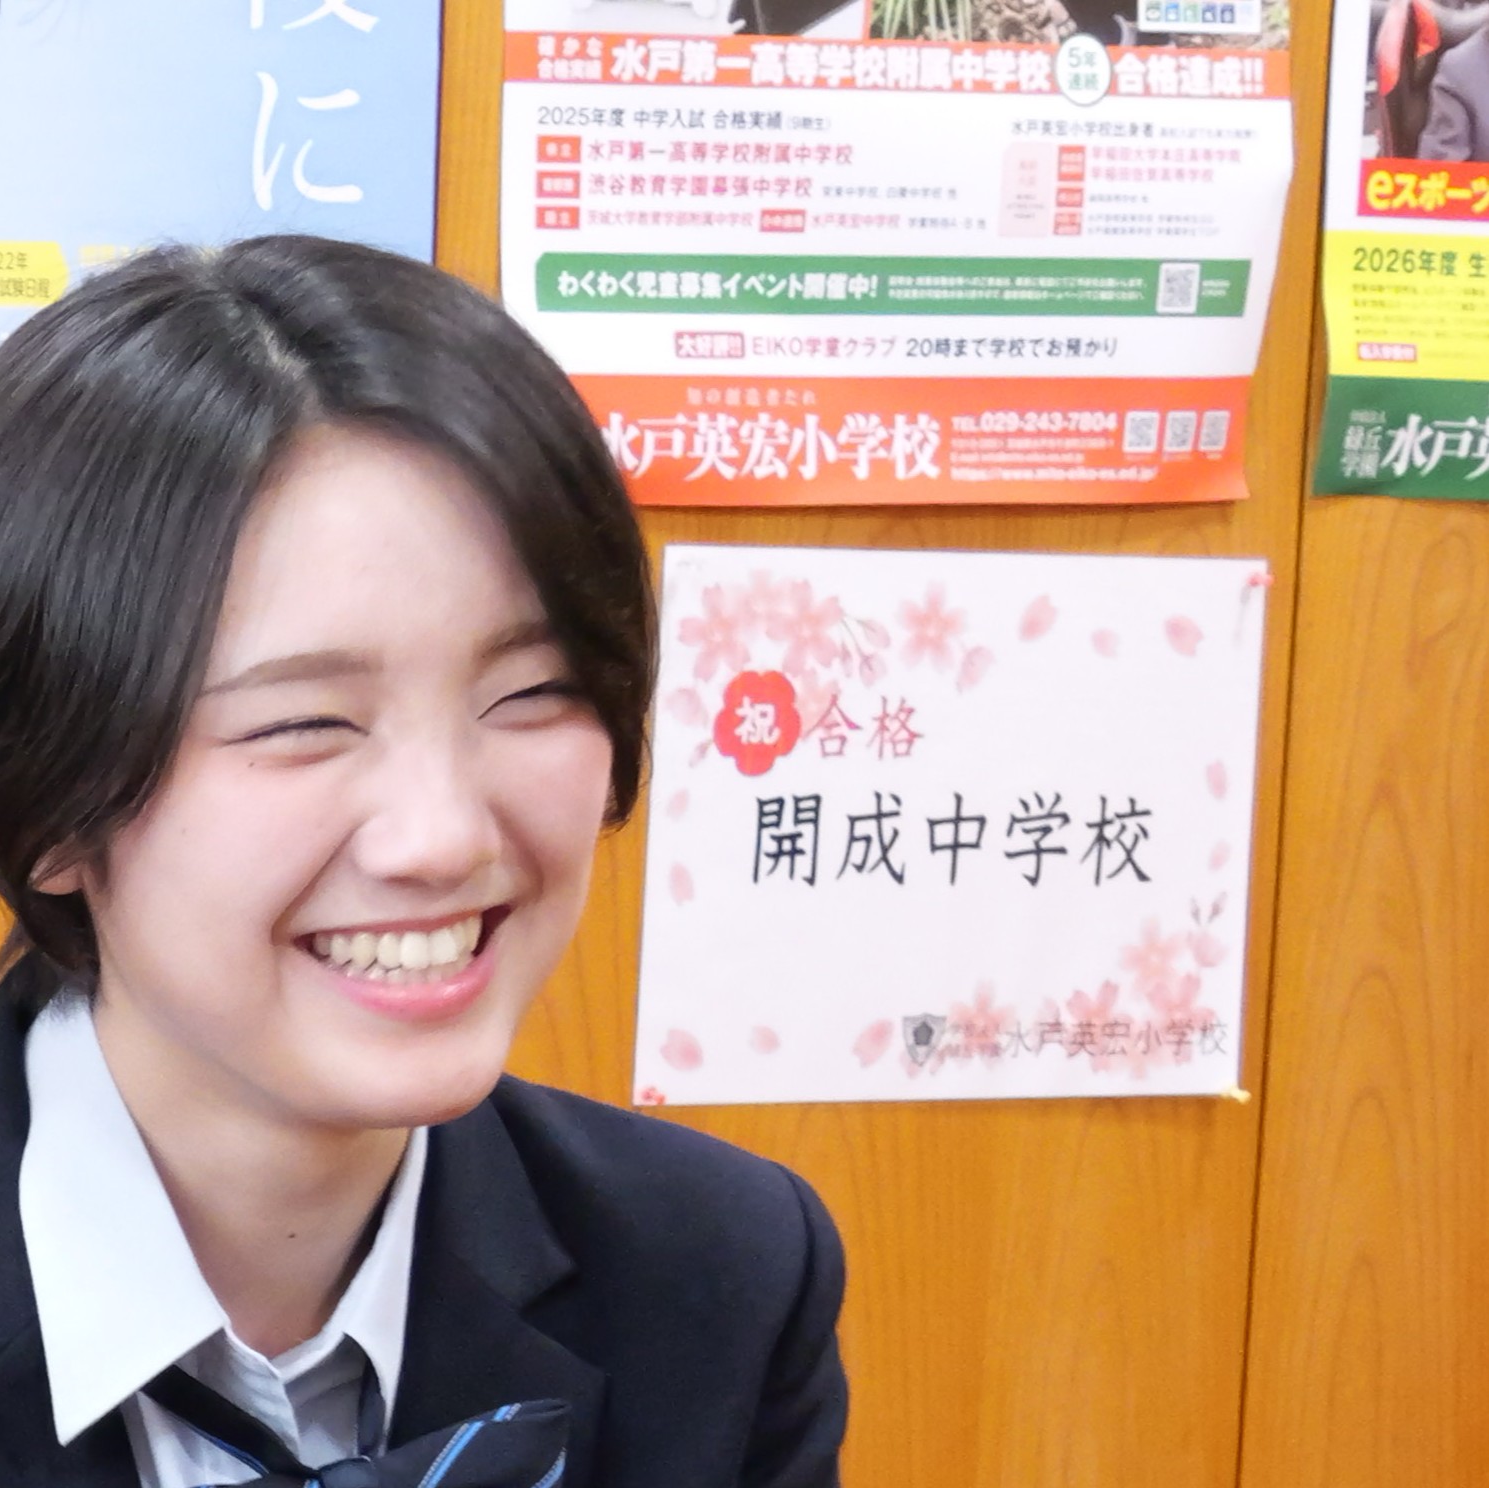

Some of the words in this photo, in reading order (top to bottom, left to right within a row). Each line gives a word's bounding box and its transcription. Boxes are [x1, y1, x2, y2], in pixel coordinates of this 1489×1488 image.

[1066, 47, 1098, 68] 5年
[536, 105, 626, 128] 2025年度
[634, 108, 705, 130] 中学入試
[1352, 246, 1459, 279] 2026年度
[1380, 413, 1489, 481] 水戸
[733, 698, 780, 746] 祝
[803, 693, 926, 762] 合格
[751, 790, 1154, 888] 開成中学校
[1005, 1018, 1228, 1057] 水戸英宏小学校
